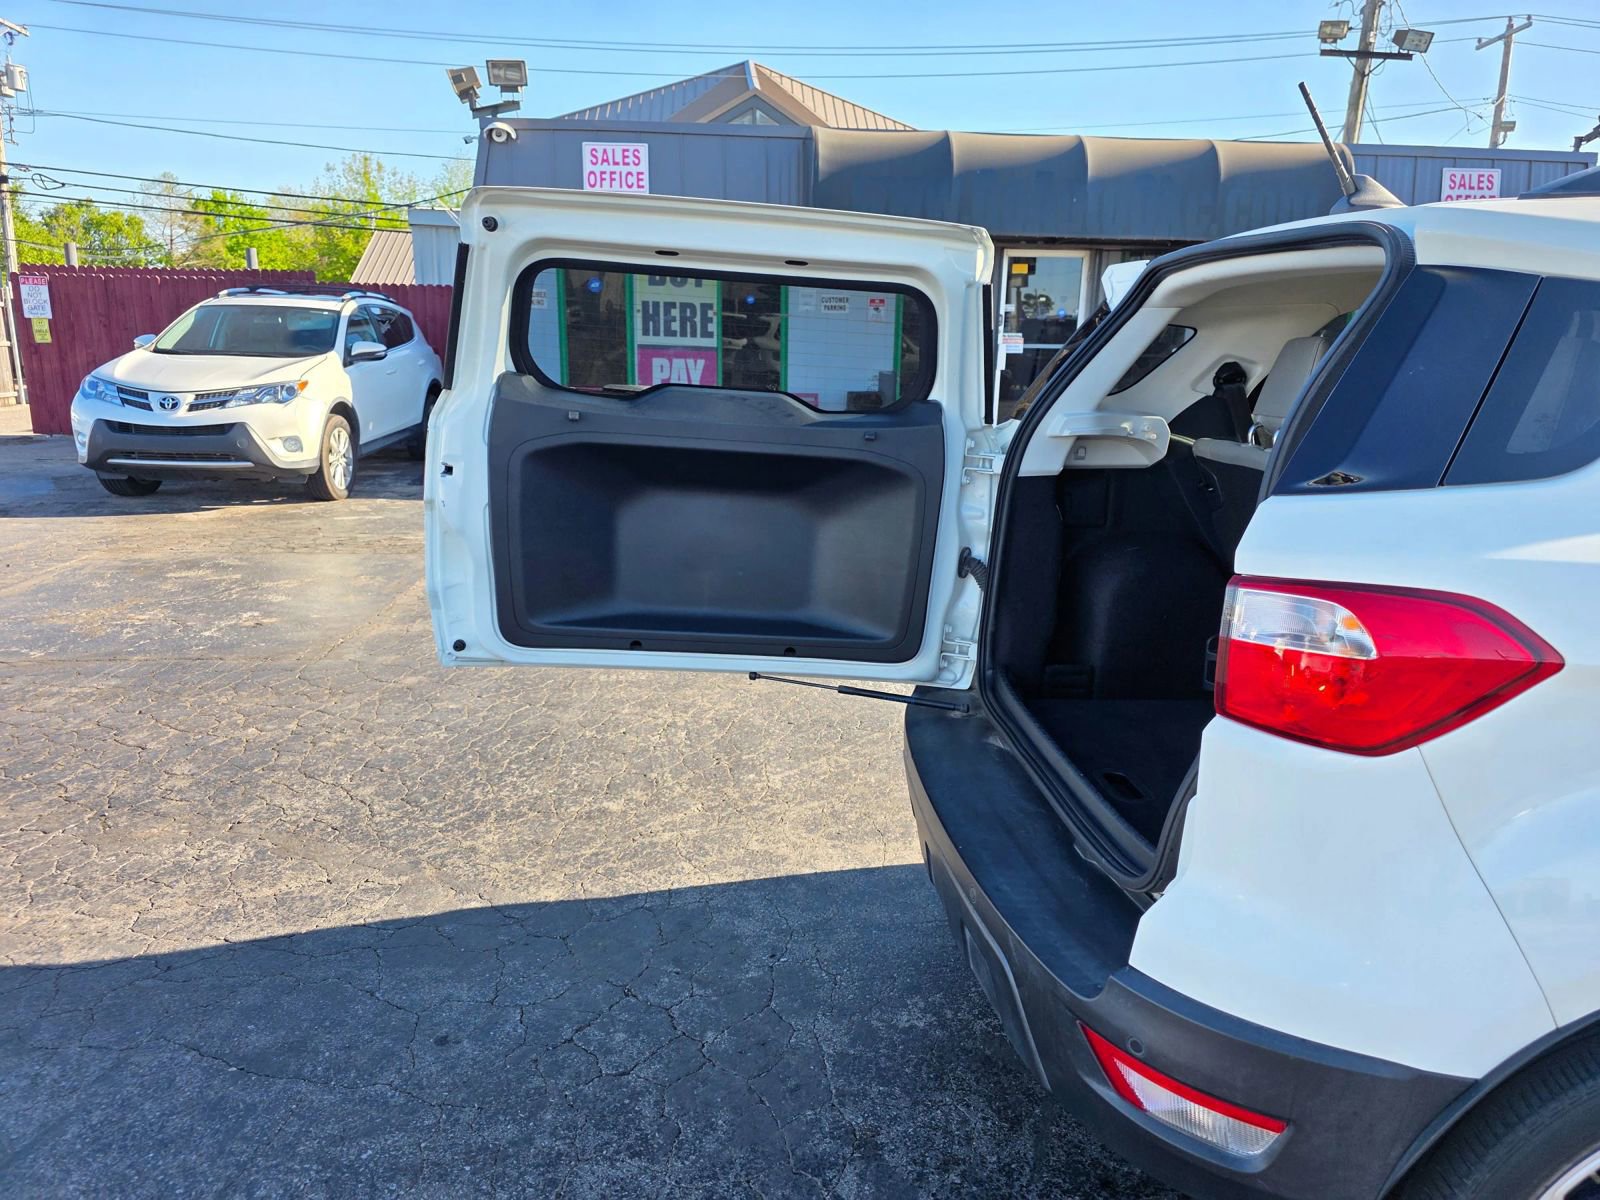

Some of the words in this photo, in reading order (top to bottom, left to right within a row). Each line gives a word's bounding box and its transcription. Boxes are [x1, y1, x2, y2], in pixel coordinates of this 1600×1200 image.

[590, 148, 641, 166] SALES
[587, 170, 645, 189] OFFICE
[1449, 173, 1494, 190] SALES
[821, 296, 849, 304] CUSTOMER
[641, 301, 715, 338] HERE
[652, 357, 706, 385] PAY
